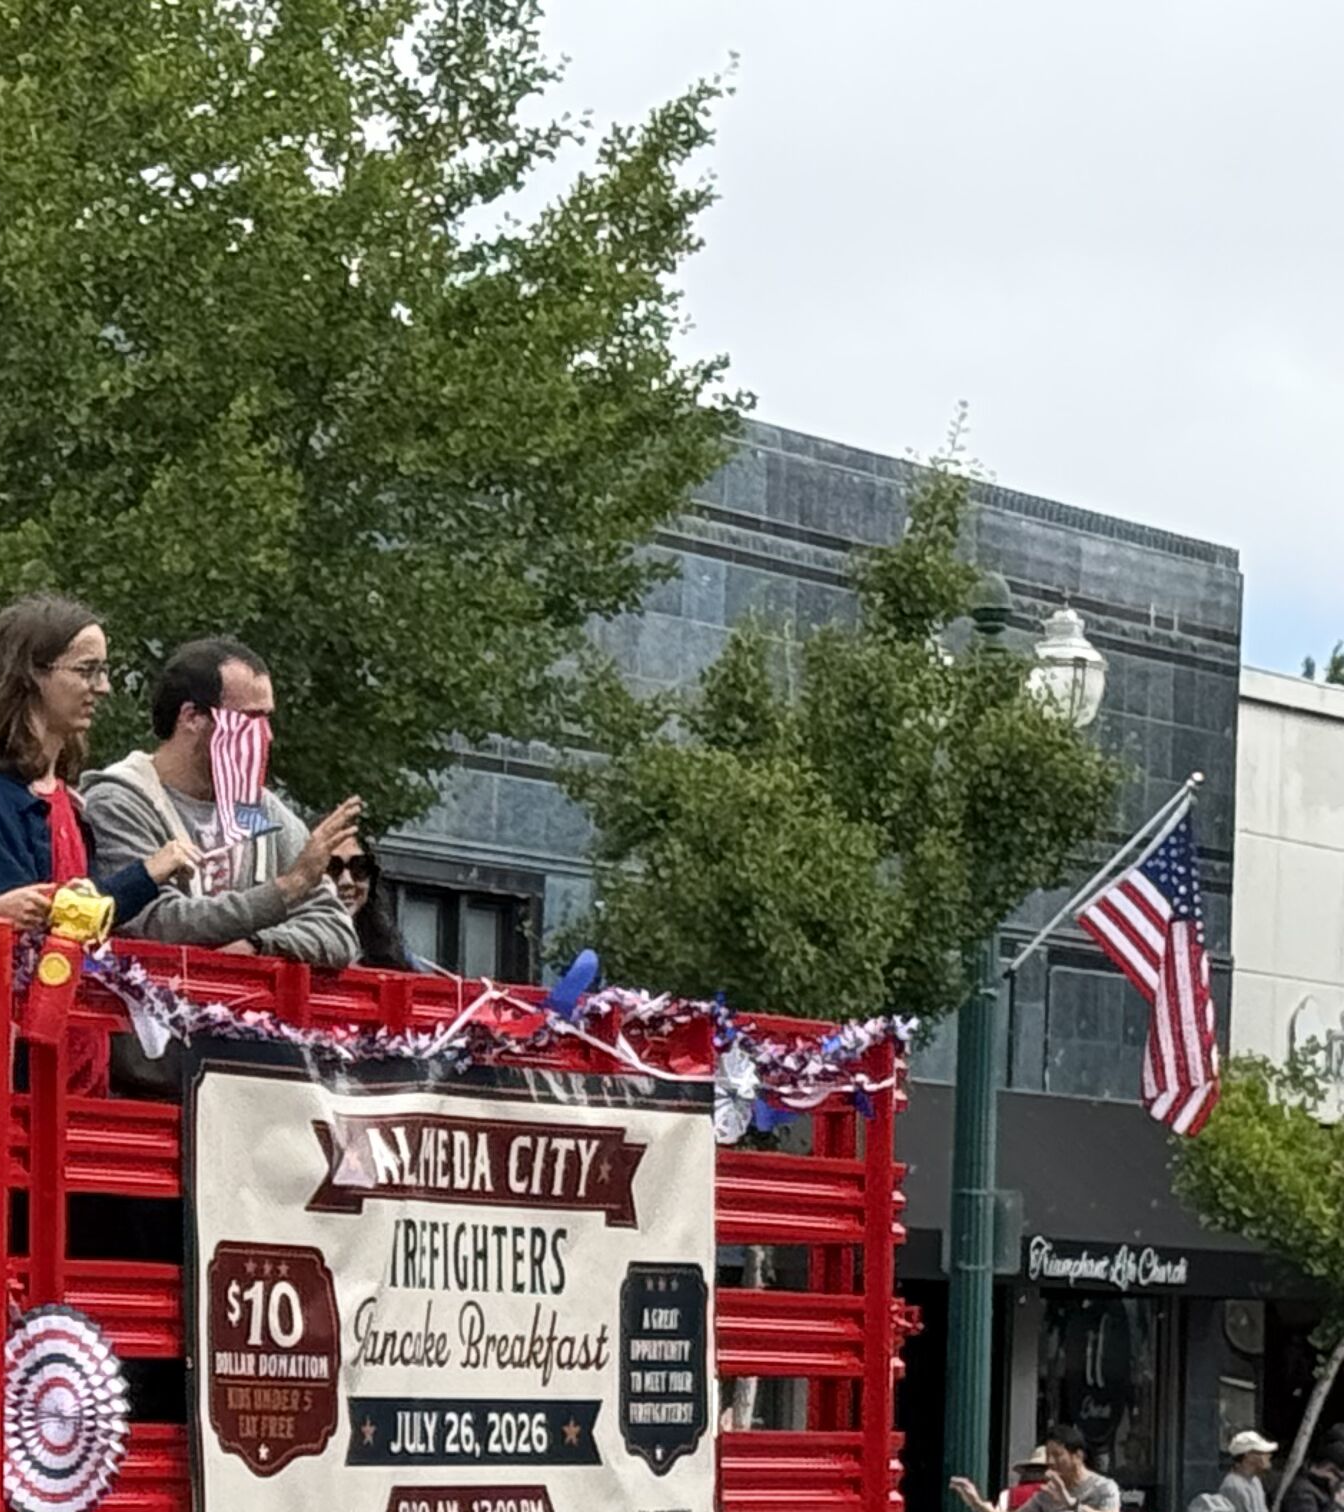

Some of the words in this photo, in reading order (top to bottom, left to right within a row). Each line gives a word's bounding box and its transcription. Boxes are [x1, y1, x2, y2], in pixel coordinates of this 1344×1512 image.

[508, 1135, 600, 1198] CITY
[227, 1279, 304, 1348] $10
[215, 1352, 256, 1376] DOLLAR
[259, 1354, 329, 1379] DONATION
[458, 1300, 611, 1387] Breakfast
[254, 1390, 300, 1411] UNDER
[261, 1416, 296, 1439] FREE
[390, 1411, 438, 1454] JULY
[444, 1411, 481, 1458] 26,
[487, 1412, 548, 1453] 2026
